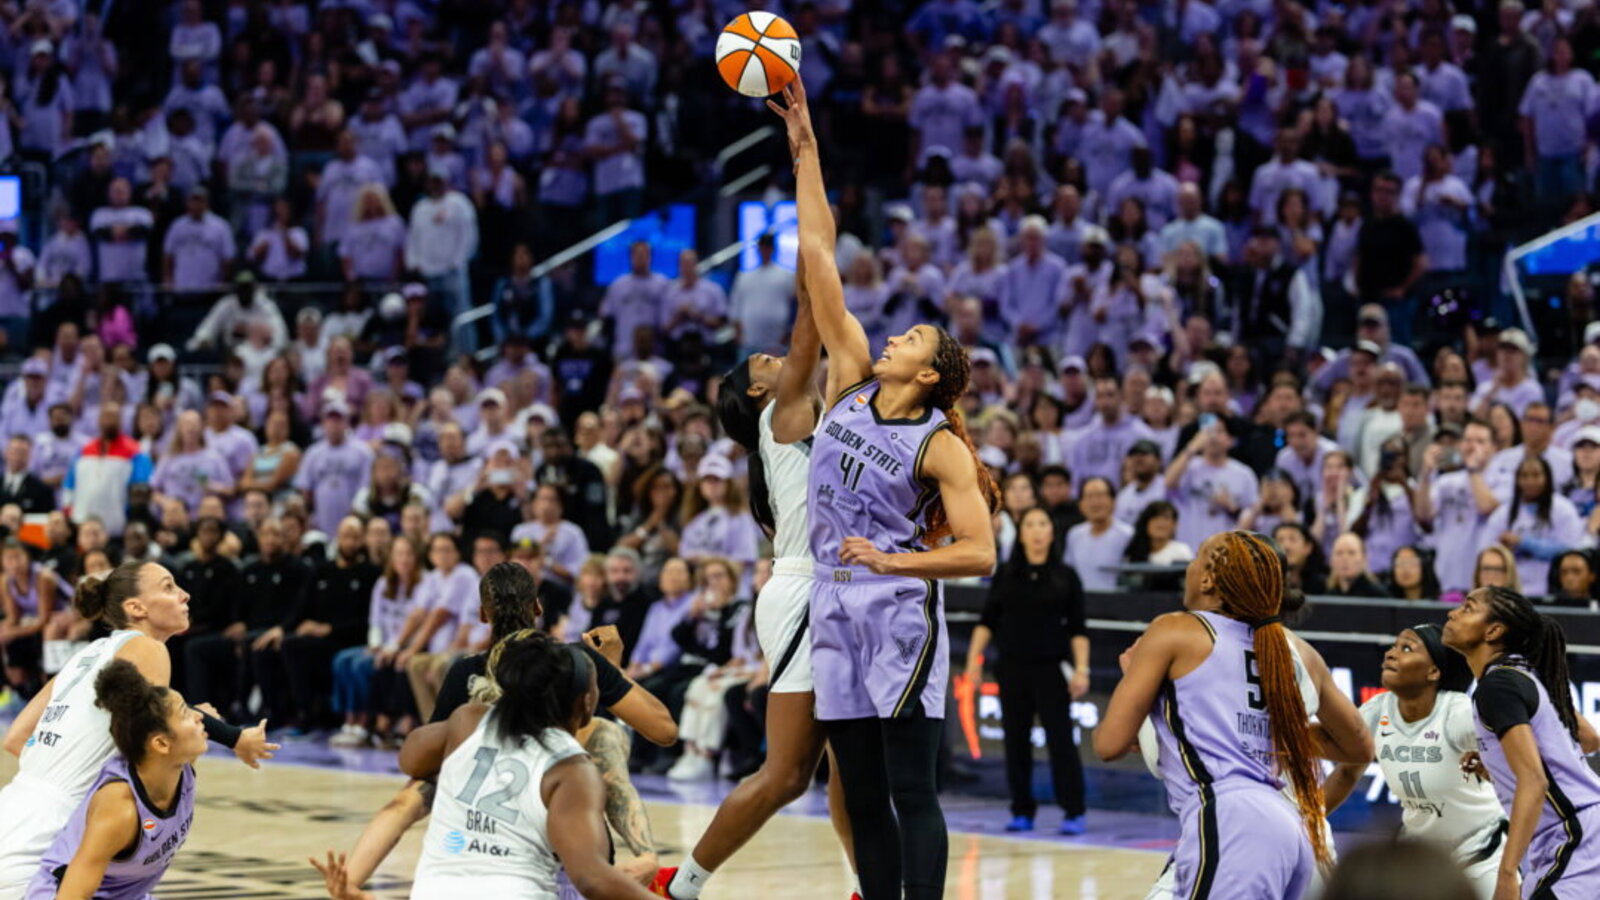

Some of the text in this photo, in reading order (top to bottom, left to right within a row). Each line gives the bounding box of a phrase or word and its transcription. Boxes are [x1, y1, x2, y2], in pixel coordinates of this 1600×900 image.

[825, 421, 903, 477] GOLDEN STATE
[840, 452, 866, 492] 41
[53, 653, 100, 702] 7
[1244, 649, 1268, 711] 5
[38, 730, 63, 748] T&T
[1236, 711, 1272, 740] THORNT
[1424, 730, 1441, 742] ally
[1380, 743, 1444, 763] ACES
[454, 746, 530, 826] 12
[1398, 769, 1428, 800] 11
